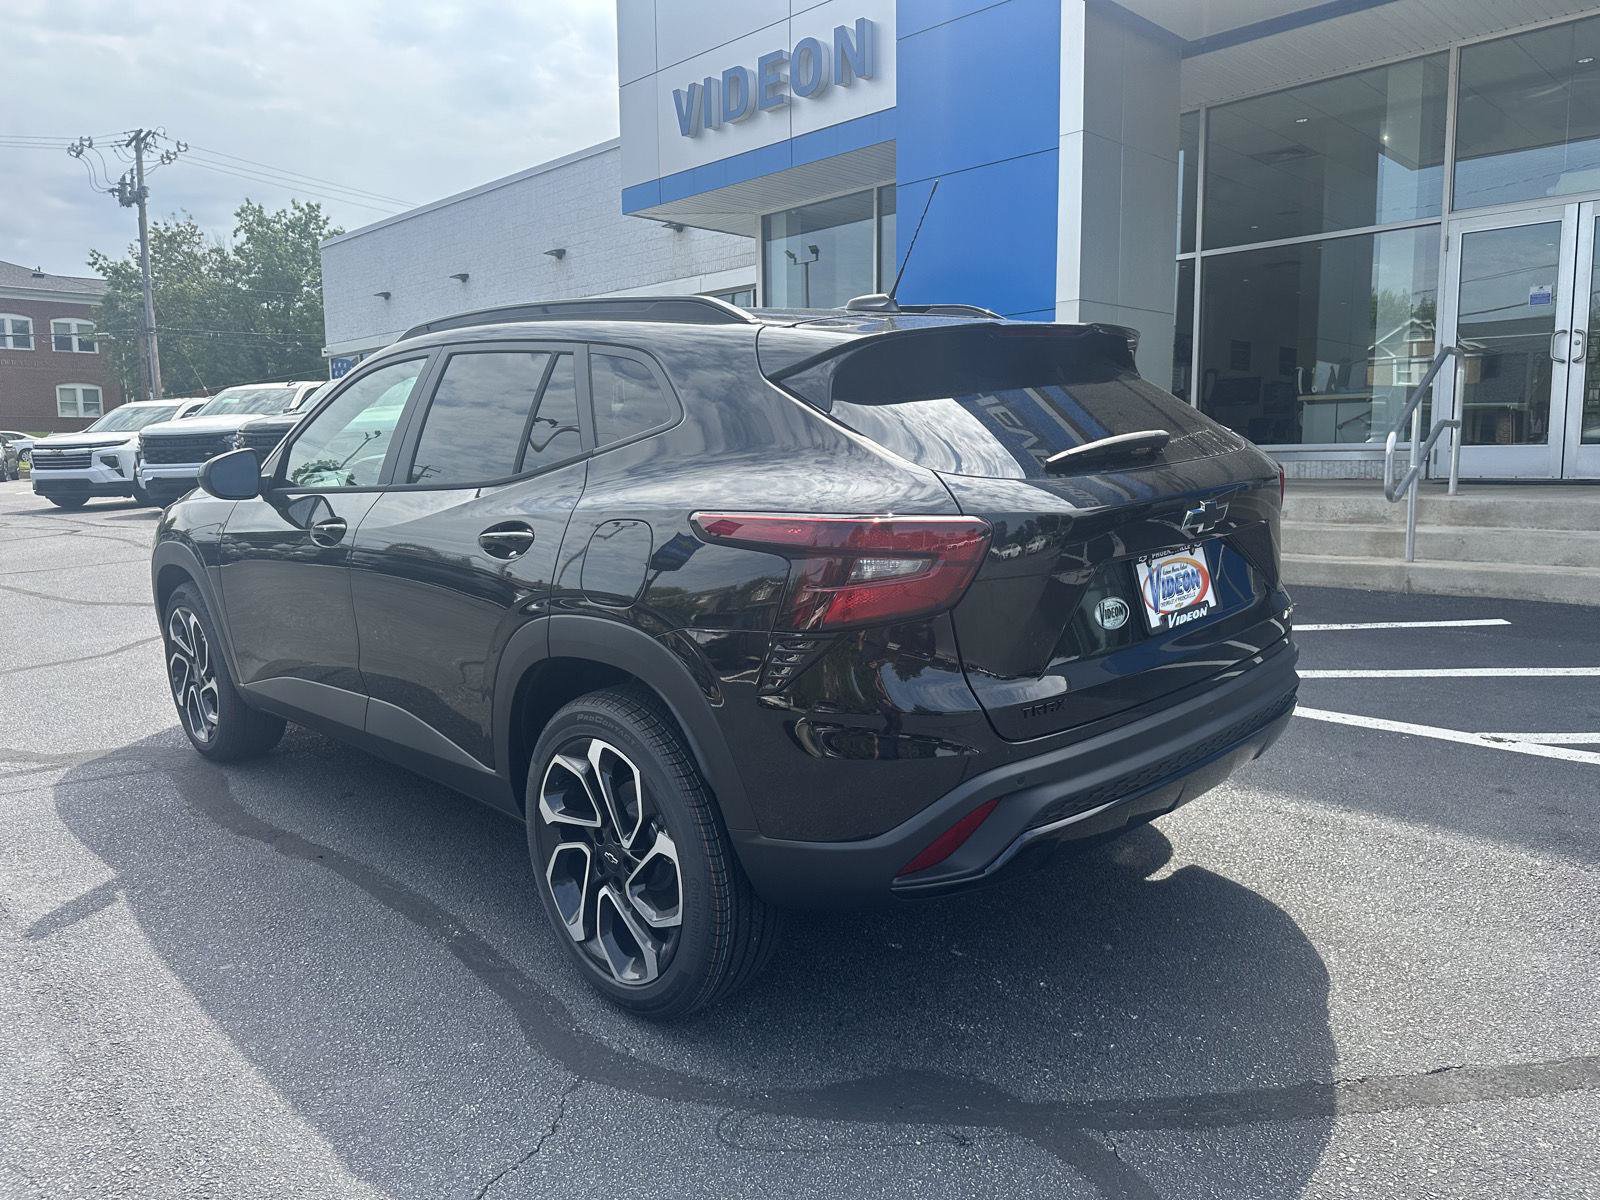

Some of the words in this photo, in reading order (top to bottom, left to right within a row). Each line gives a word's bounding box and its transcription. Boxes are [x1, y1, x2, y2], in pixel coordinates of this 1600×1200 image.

[673, 17, 873, 138] VIDEON
[1148, 563, 1201, 615] VIDEON
[1099, 602, 1125, 627] VIDEON
[1168, 606, 1209, 629] VIDEON
